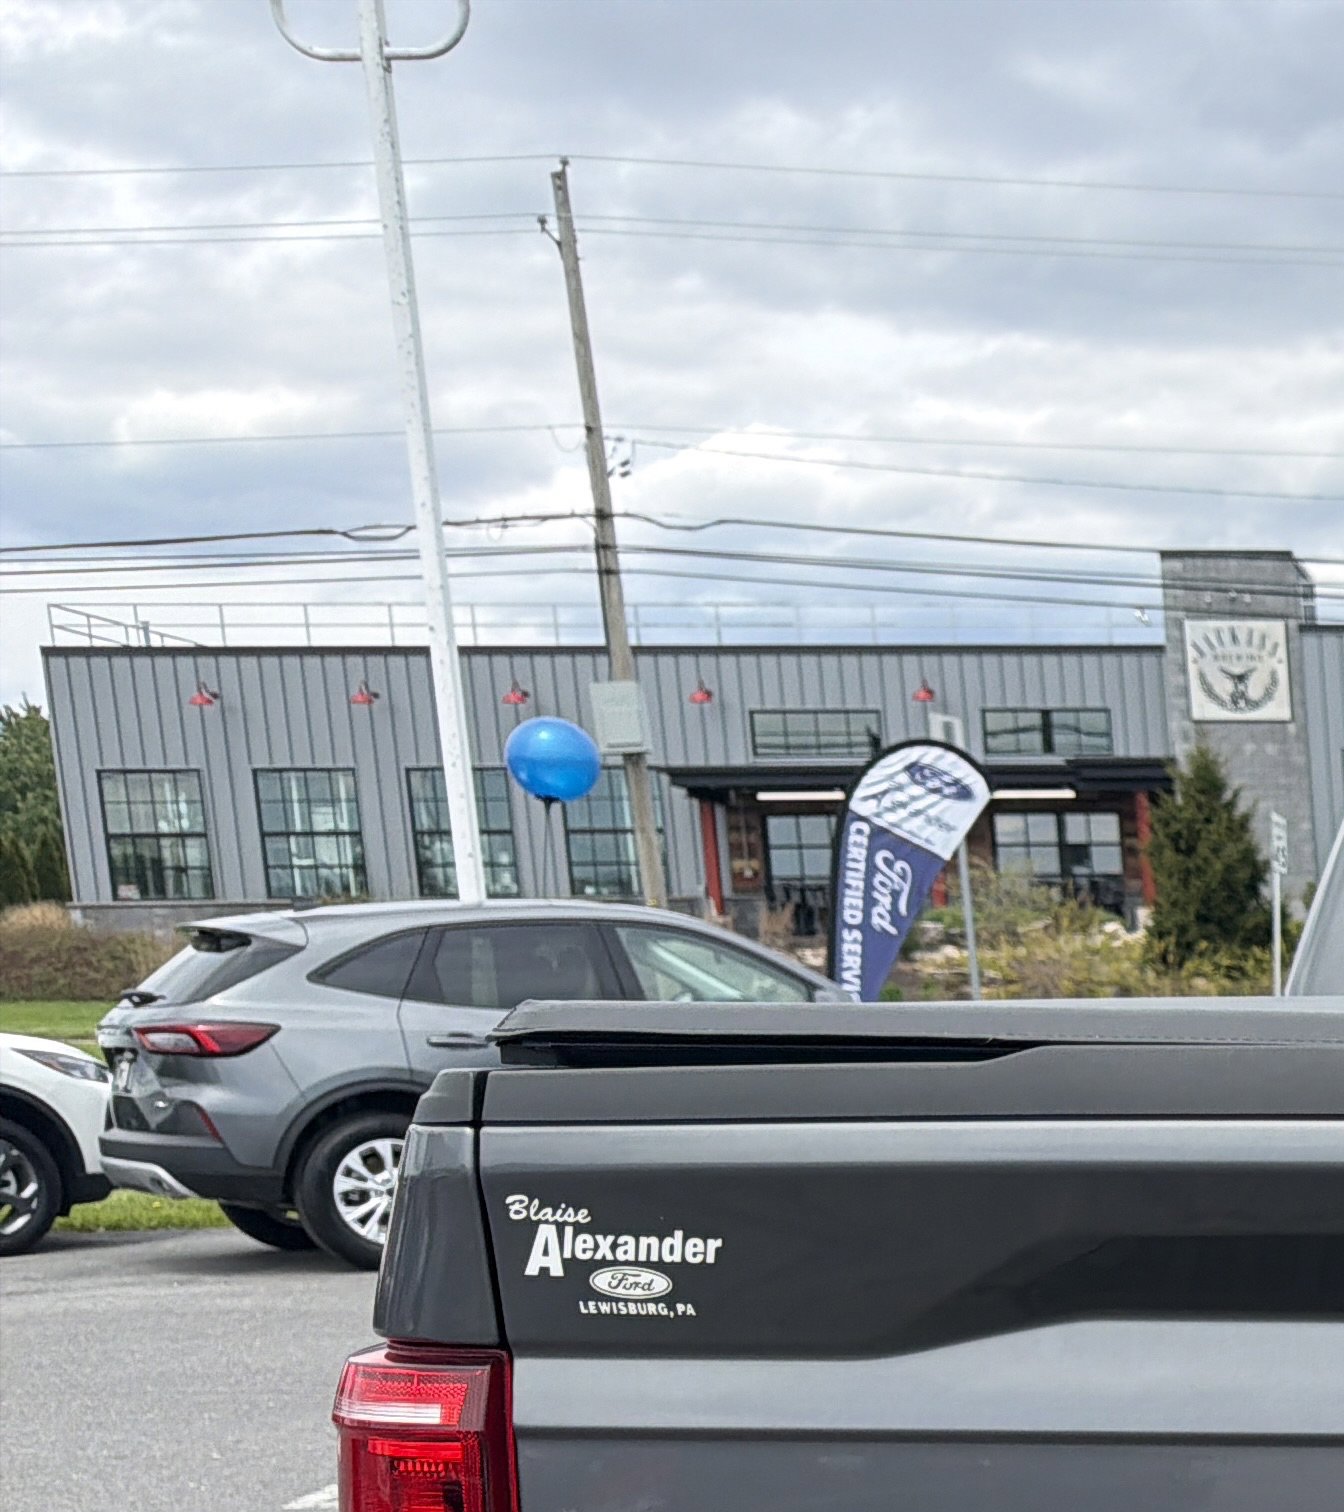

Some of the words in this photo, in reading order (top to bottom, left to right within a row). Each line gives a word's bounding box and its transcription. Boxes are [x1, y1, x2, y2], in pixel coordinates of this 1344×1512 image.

[842, 821, 870, 926] CERTIFIED
[870, 849, 912, 937] Ford
[505, 1194, 592, 1224] Blaise
[524, 1224, 723, 1277] Alexander
[607, 1272, 656, 1292] Ford
[578, 1300, 675, 1319] LEWISBURG,
[676, 1303, 697, 1317] PA
